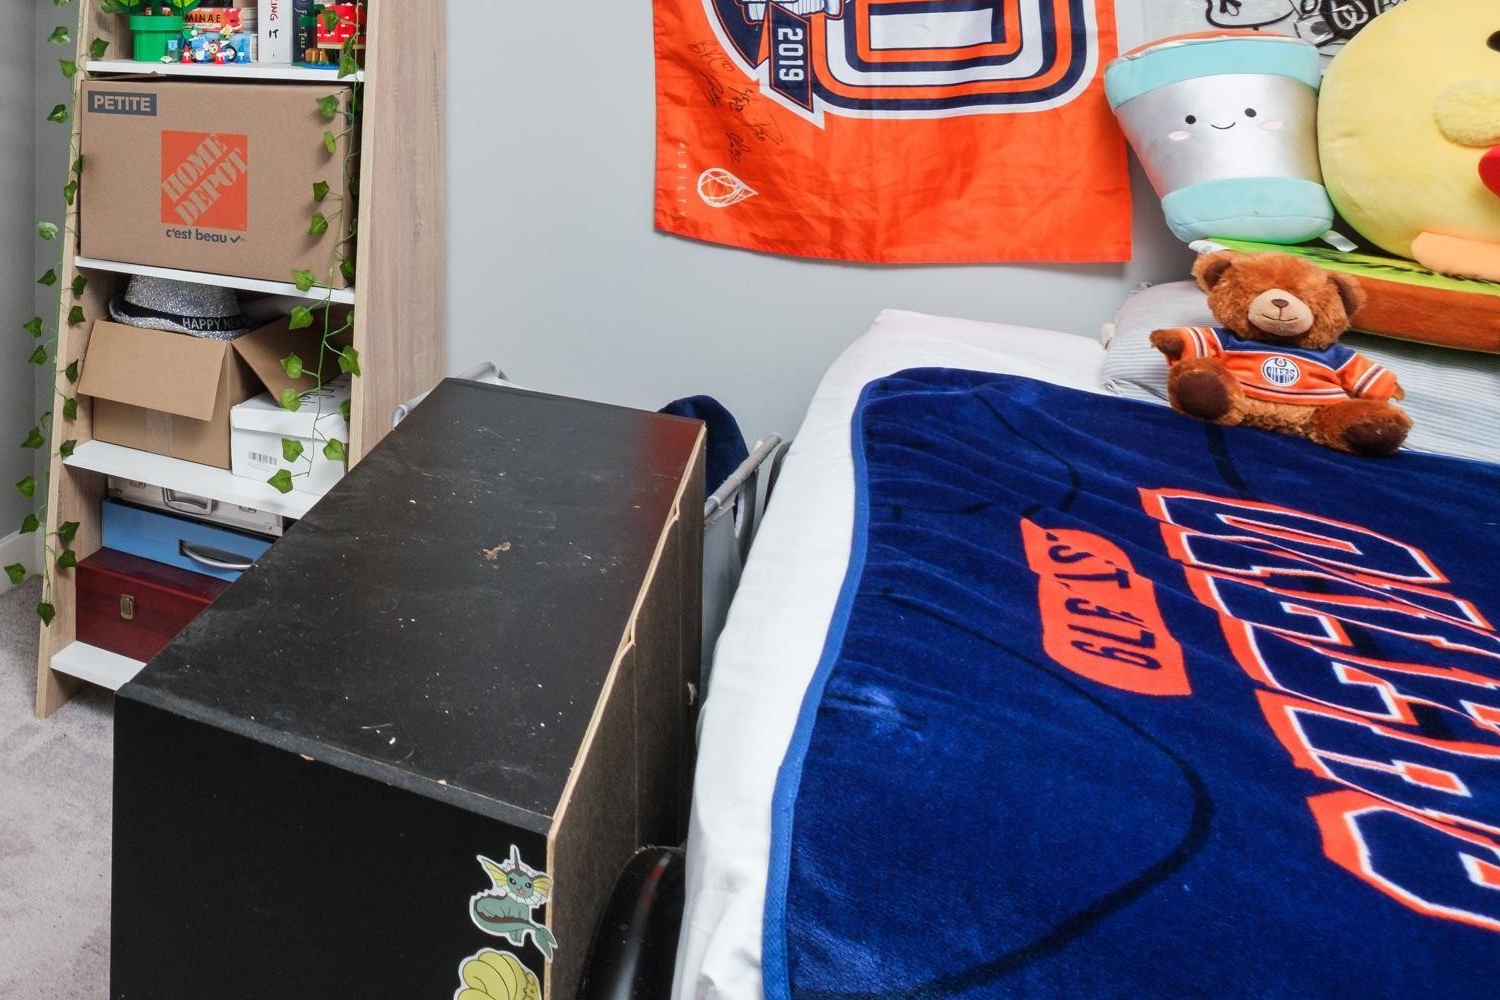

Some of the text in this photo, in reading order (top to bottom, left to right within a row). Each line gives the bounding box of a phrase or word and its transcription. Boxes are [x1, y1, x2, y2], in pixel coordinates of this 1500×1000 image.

[777, 27, 805, 82] 2019
[93, 94, 151, 112] PETITE
[161, 132, 228, 203] HOME
[174, 147, 248, 227] DEPOT
[165, 228, 228, 243] c'est beau
[182, 317, 221, 331] HAPPY
[1266, 366, 1296, 381] OILERS
